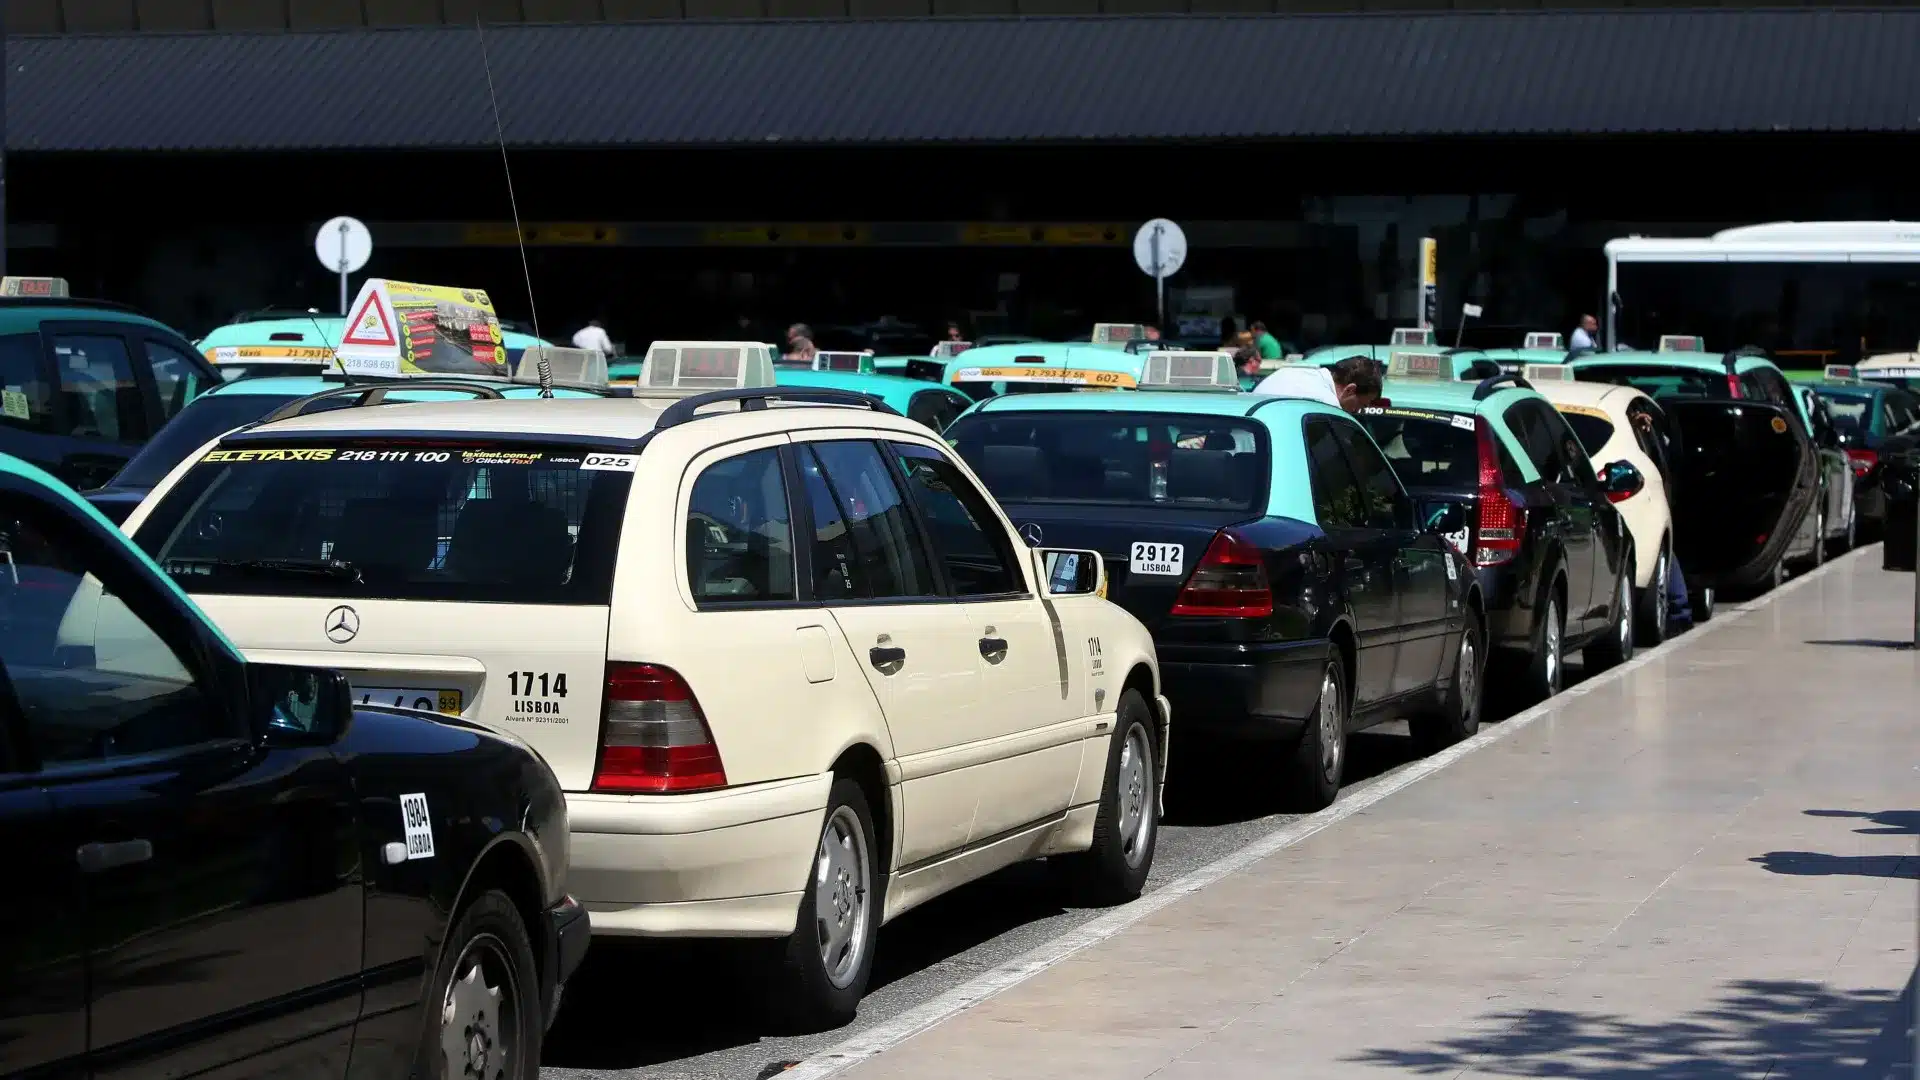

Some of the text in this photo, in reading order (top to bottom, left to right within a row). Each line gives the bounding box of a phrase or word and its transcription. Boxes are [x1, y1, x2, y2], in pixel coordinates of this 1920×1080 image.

[286, 348, 297, 357] 21
[302, 349, 321, 358] 793
[346, 359, 395, 369] 218 598 693
[1024, 369, 1036, 377] 21
[1037, 369, 1056, 378] 793
[1096, 373, 1120, 384] 602
[1364, 407, 1384, 415] 100
[200, 449, 451, 463] ELETAXIS 218 111 100
[461, 450, 543, 460] taxinet.com.pt
[475, 457, 534, 465] Click4Taxi
[585, 456, 631, 467] 025
[1135, 544, 1180, 563] 2912
[1141, 563, 1171, 573] LISBOA
[1087, 636, 1102, 657] 1714
[507, 671, 568, 698] 1714
[514, 700, 560, 715] LISBOA
[403, 797, 428, 829] 1984
[408, 832, 432, 855] LISBOA
